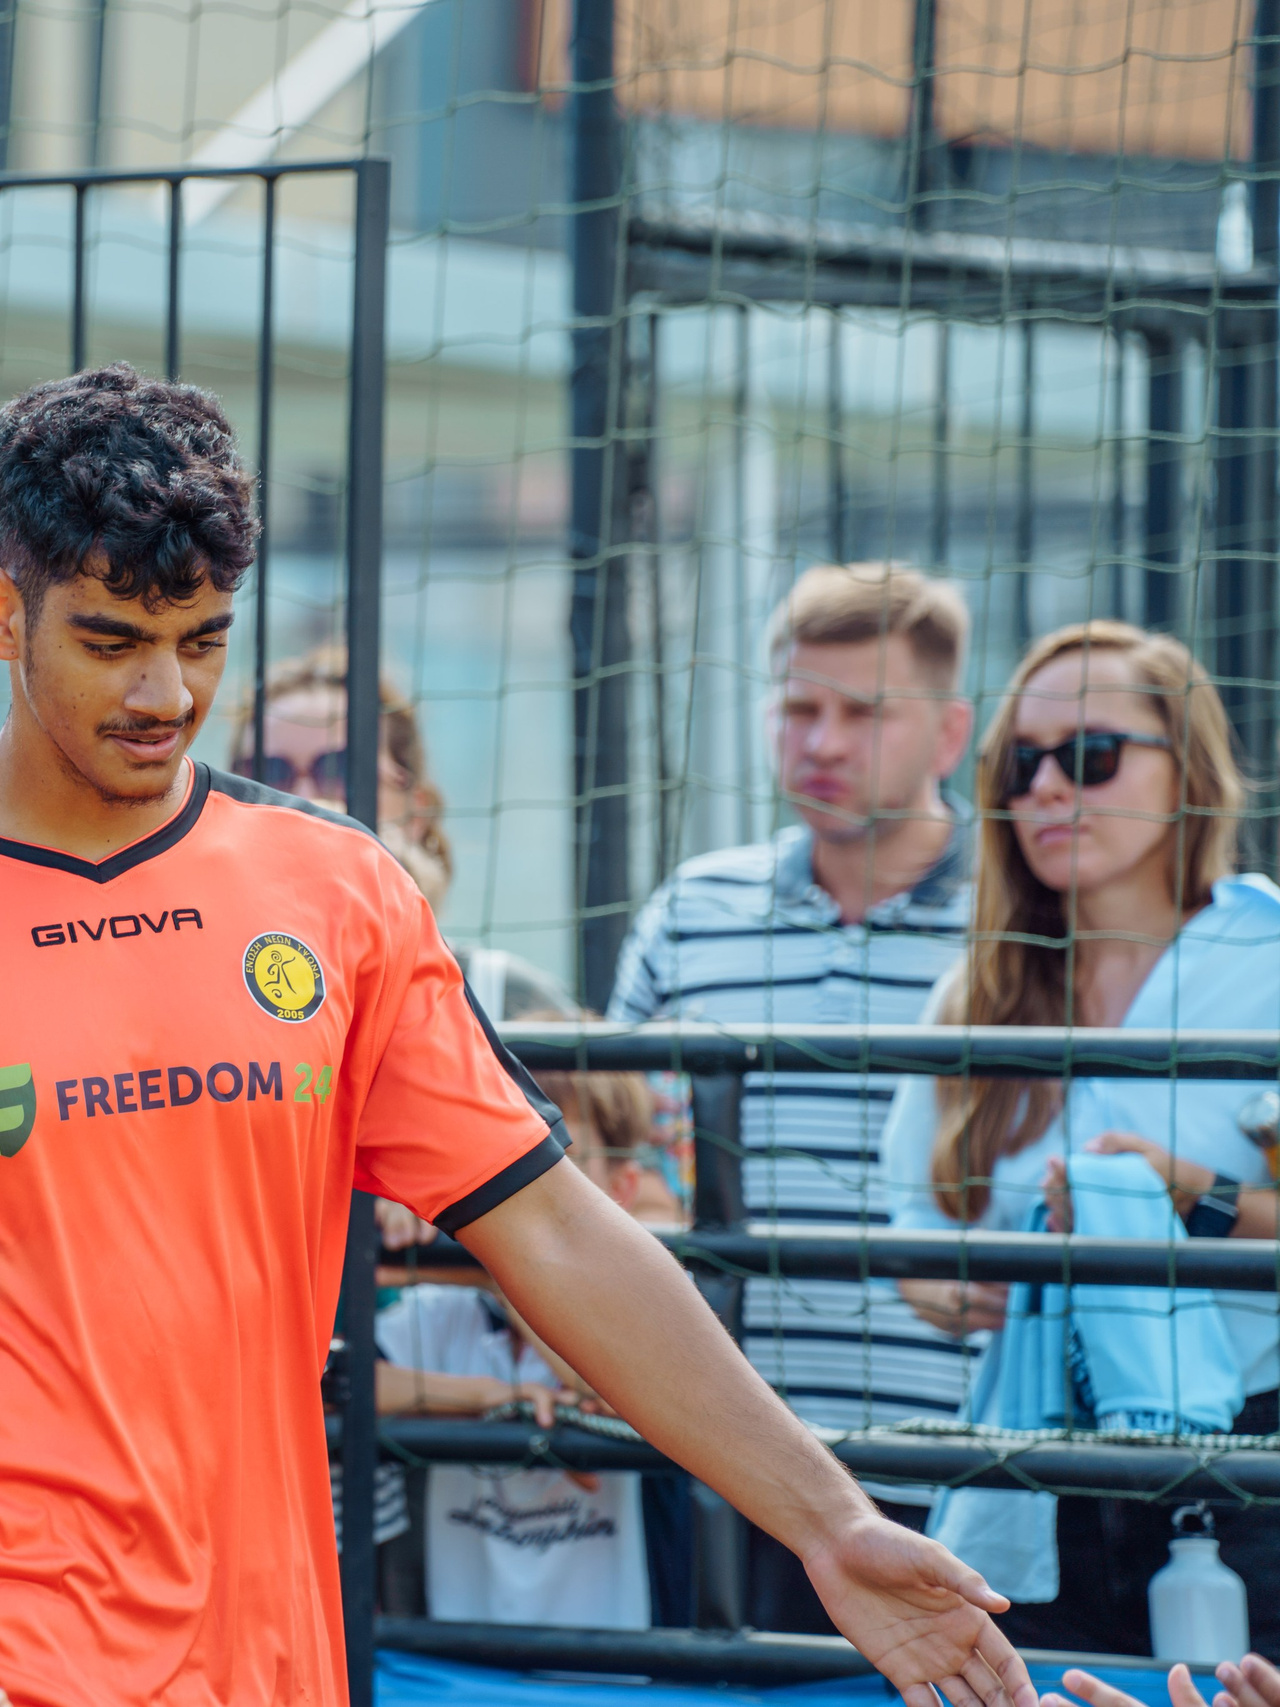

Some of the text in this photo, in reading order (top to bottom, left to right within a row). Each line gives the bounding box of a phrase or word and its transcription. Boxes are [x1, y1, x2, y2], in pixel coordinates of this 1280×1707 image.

[30, 908, 204, 948] GIVOVA
[245, 935, 321, 980] ΕΝΩΣΗ ΝΕΩΝ ΥΨΩΝΑ
[276, 1009, 305, 1020] 2005
[55, 1061, 333, 1121] FREEDOM 24
